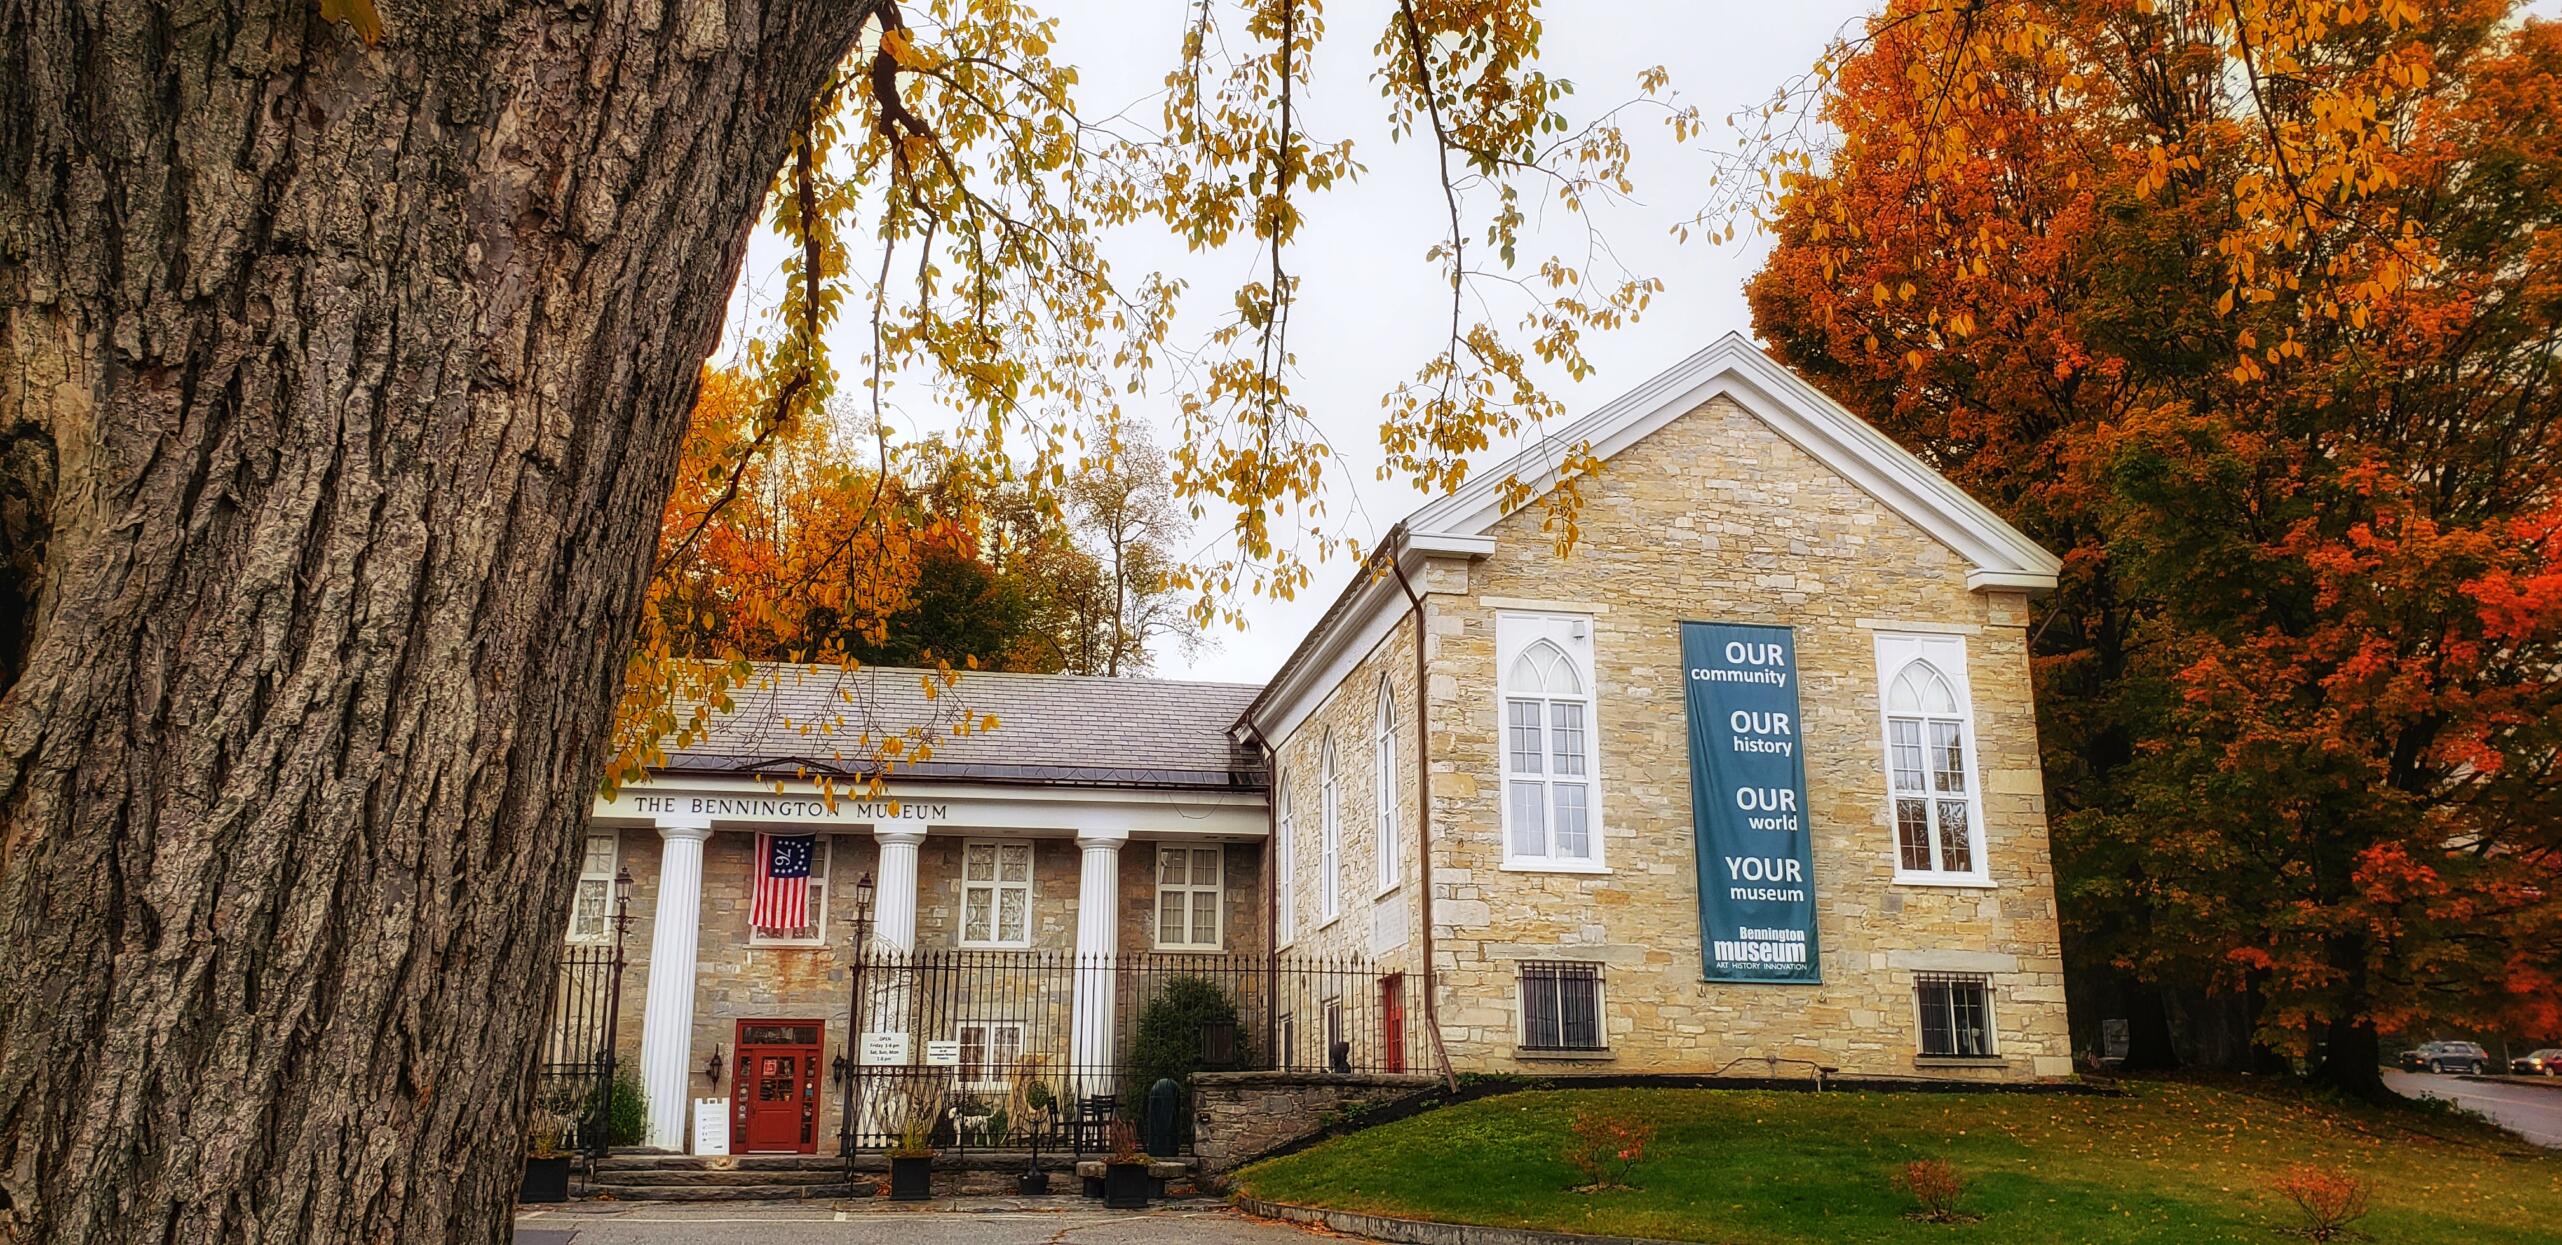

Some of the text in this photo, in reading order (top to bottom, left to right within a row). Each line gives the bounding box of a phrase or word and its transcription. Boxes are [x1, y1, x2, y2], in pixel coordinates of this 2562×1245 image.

[1725, 641, 1785, 666] OUR
[1691, 668, 1786, 688] community
[1730, 710, 1791, 735] OUR
[1733, 736, 1793, 757] history
[634, 797, 676, 813] THE
[857, 803, 948, 820] MUEUM
[1736, 787, 1797, 812] OUR
[1748, 815, 1798, 831] world
[1725, 856, 1803, 882] YOUR
[1730, 887, 1804, 902] museum
[1739, 926, 1805, 942] Bennington
[1713, 940, 1806, 963] museum
[1732, 962, 1761, 970] HISTORY
